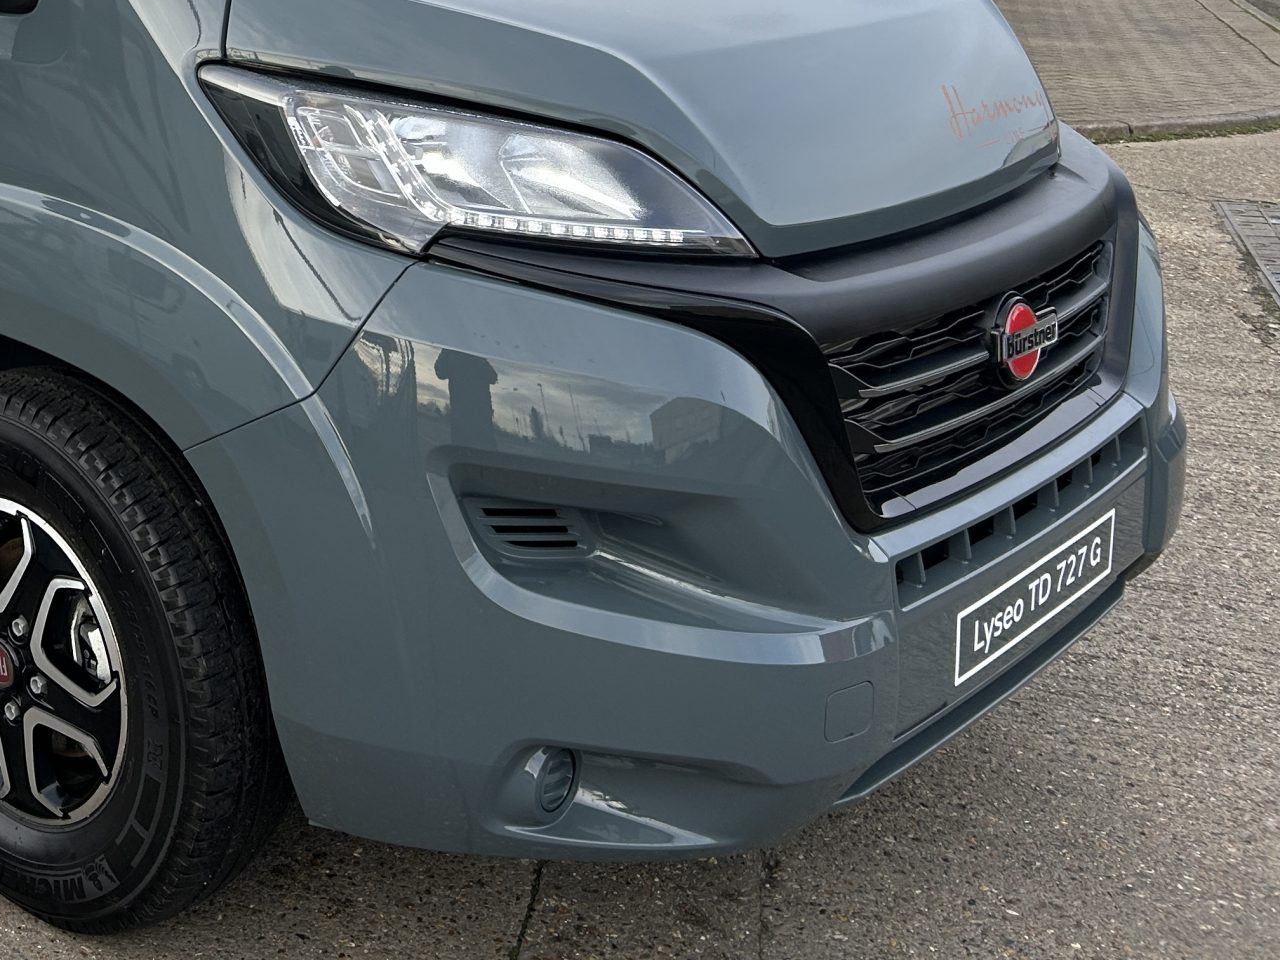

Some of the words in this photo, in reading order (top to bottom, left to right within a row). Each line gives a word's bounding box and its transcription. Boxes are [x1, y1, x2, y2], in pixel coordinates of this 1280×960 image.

[1007, 321, 1057, 360] bürstner
[973, 598, 1024, 654] Lyseo
[1028, 572, 1052, 611] TD
[1056, 545, 1088, 593] 727
[1090, 536, 1101, 567] G
